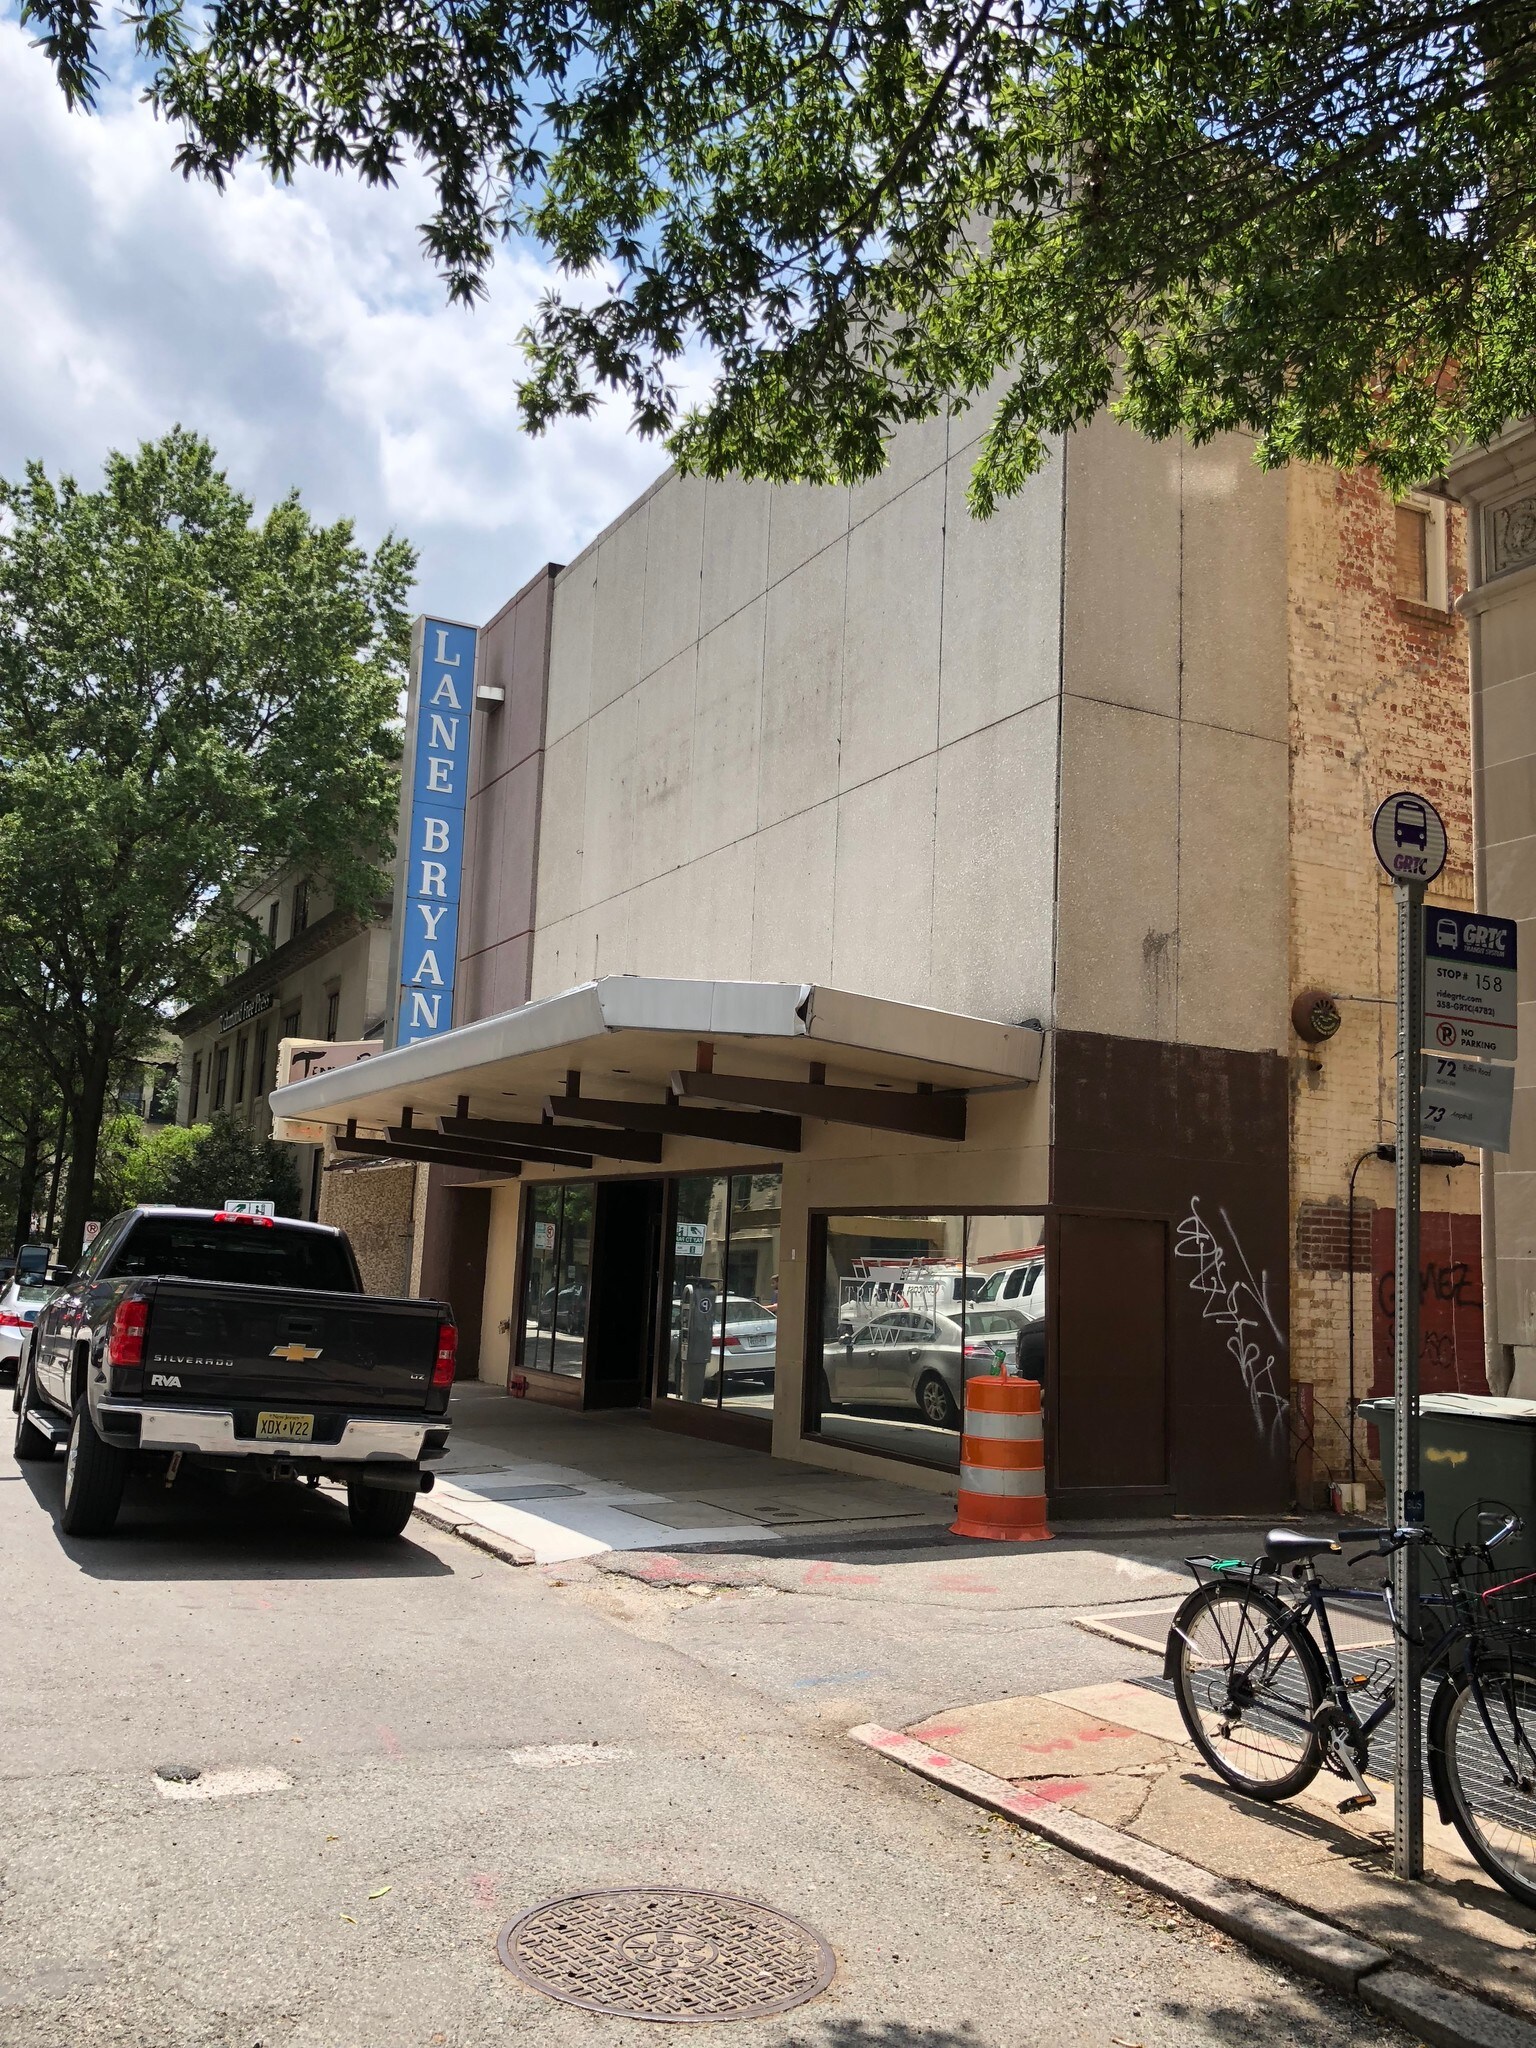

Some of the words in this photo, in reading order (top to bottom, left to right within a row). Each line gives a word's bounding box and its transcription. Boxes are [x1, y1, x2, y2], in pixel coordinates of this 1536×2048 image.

[426, 630, 462, 795] LANE
[1393, 853, 1428, 875] GRTC
[409, 817, 450, 1044] BRYAN
[1463, 923, 1508, 951] GRTC
[1436, 967, 1461, 980] STOP
[1462, 972, 1469, 981] #
[1475, 973, 1503, 992] 158
[1461, 1028, 1474, 1038] NO
[1461, 1039, 1497, 1051] PARKING
[1437, 1059, 1457, 1078] 72
[1424, 1105, 1446, 1122] 73
[153, 1354, 234, 1367] SILVERADO
[151, 1374, 182, 1388] RVA
[260, 1419, 282, 1435] XDX
[289, 1421, 310, 1436] V22
